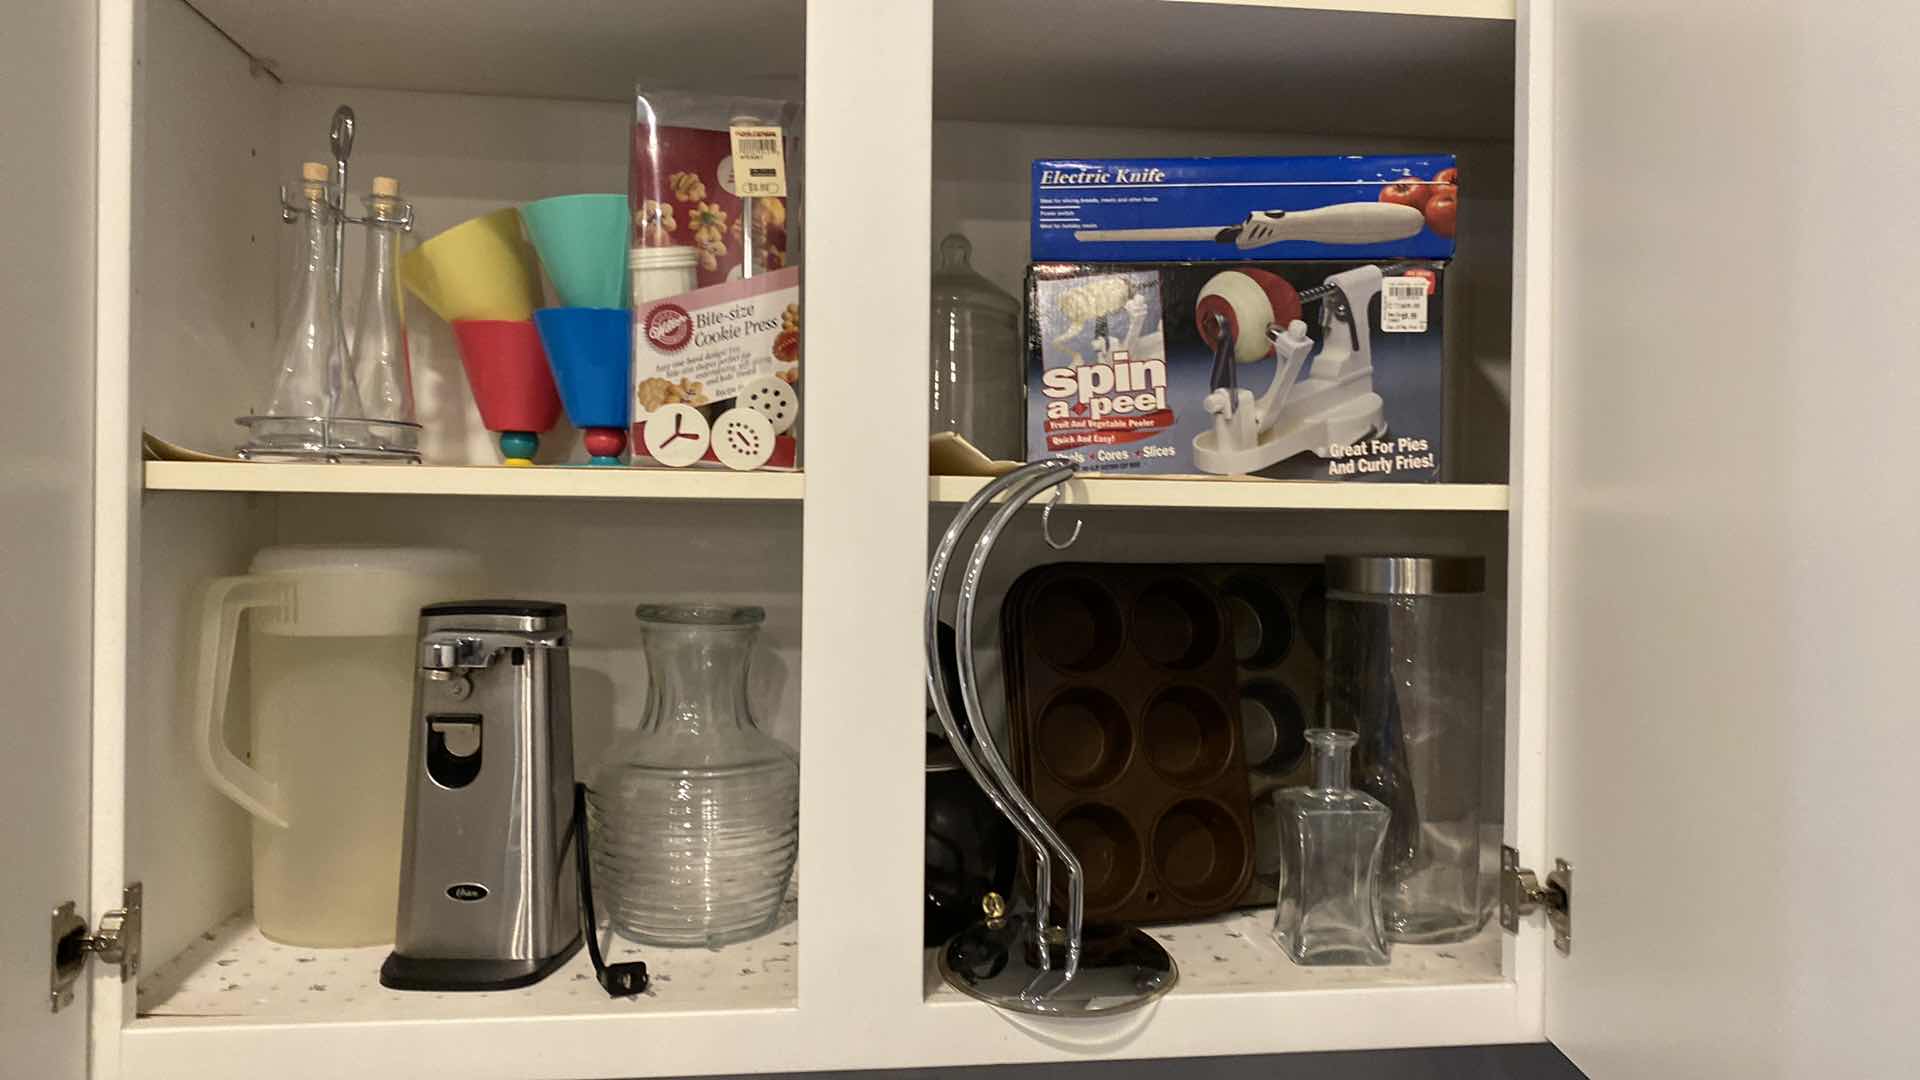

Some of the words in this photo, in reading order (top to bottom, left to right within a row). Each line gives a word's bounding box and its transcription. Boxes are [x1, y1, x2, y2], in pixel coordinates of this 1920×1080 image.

[1040, 170, 1111, 184] Electric
[1116, 168, 1165, 183] Knife
[696, 303, 754, 329] Bite-size
[694, 325, 741, 348] Cookie
[744, 317, 778, 336] Press
[1042, 351, 1167, 404] spin
[1090, 386, 1167, 419] peel
[1050, 421, 1070, 429] Fruit
[1070, 420, 1088, 428] And
[1088, 419, 1127, 429] Vegetable
[1128, 419, 1155, 428] Peeler
[1052, 436, 1074, 445] Quick
[1076, 435, 1092, 443] And
[1093, 434, 1116, 445] Easy!
[1329, 441, 1368, 458] Great
[1371, 439, 1395, 454] For
[1397, 437, 1428, 452] Pies
[1097, 449, 1129, 461] Cores
[1143, 445, 1176, 458] Slices
[1328, 459, 1355, 475] And
[1358, 457, 1393, 474] Curly
[1395, 453, 1435, 469] Fries!
